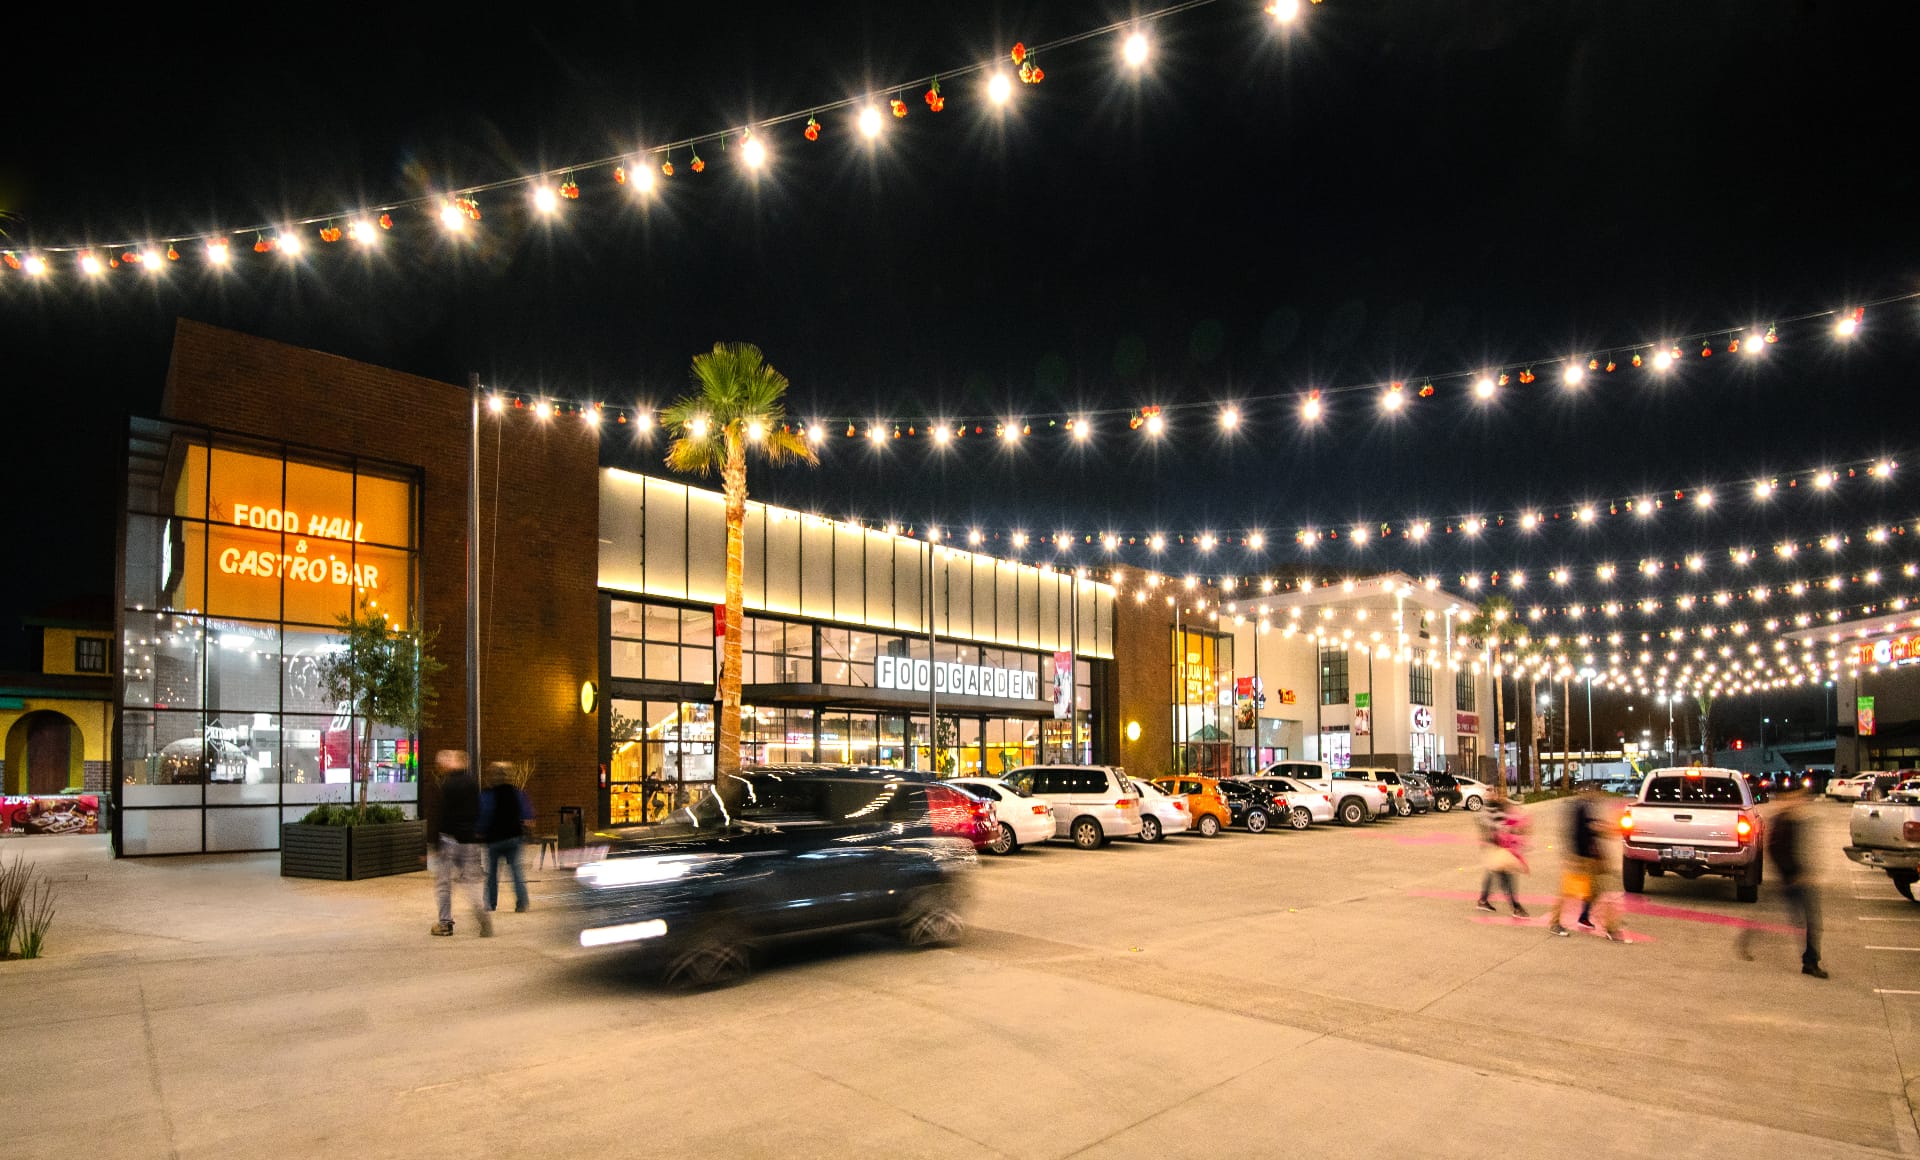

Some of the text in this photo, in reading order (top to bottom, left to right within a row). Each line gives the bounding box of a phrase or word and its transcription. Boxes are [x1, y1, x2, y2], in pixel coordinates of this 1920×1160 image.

[234, 504, 366, 542] FOOD HALL
[296, 539, 308, 553] &
[219, 548, 378, 588] GASTRO BAR
